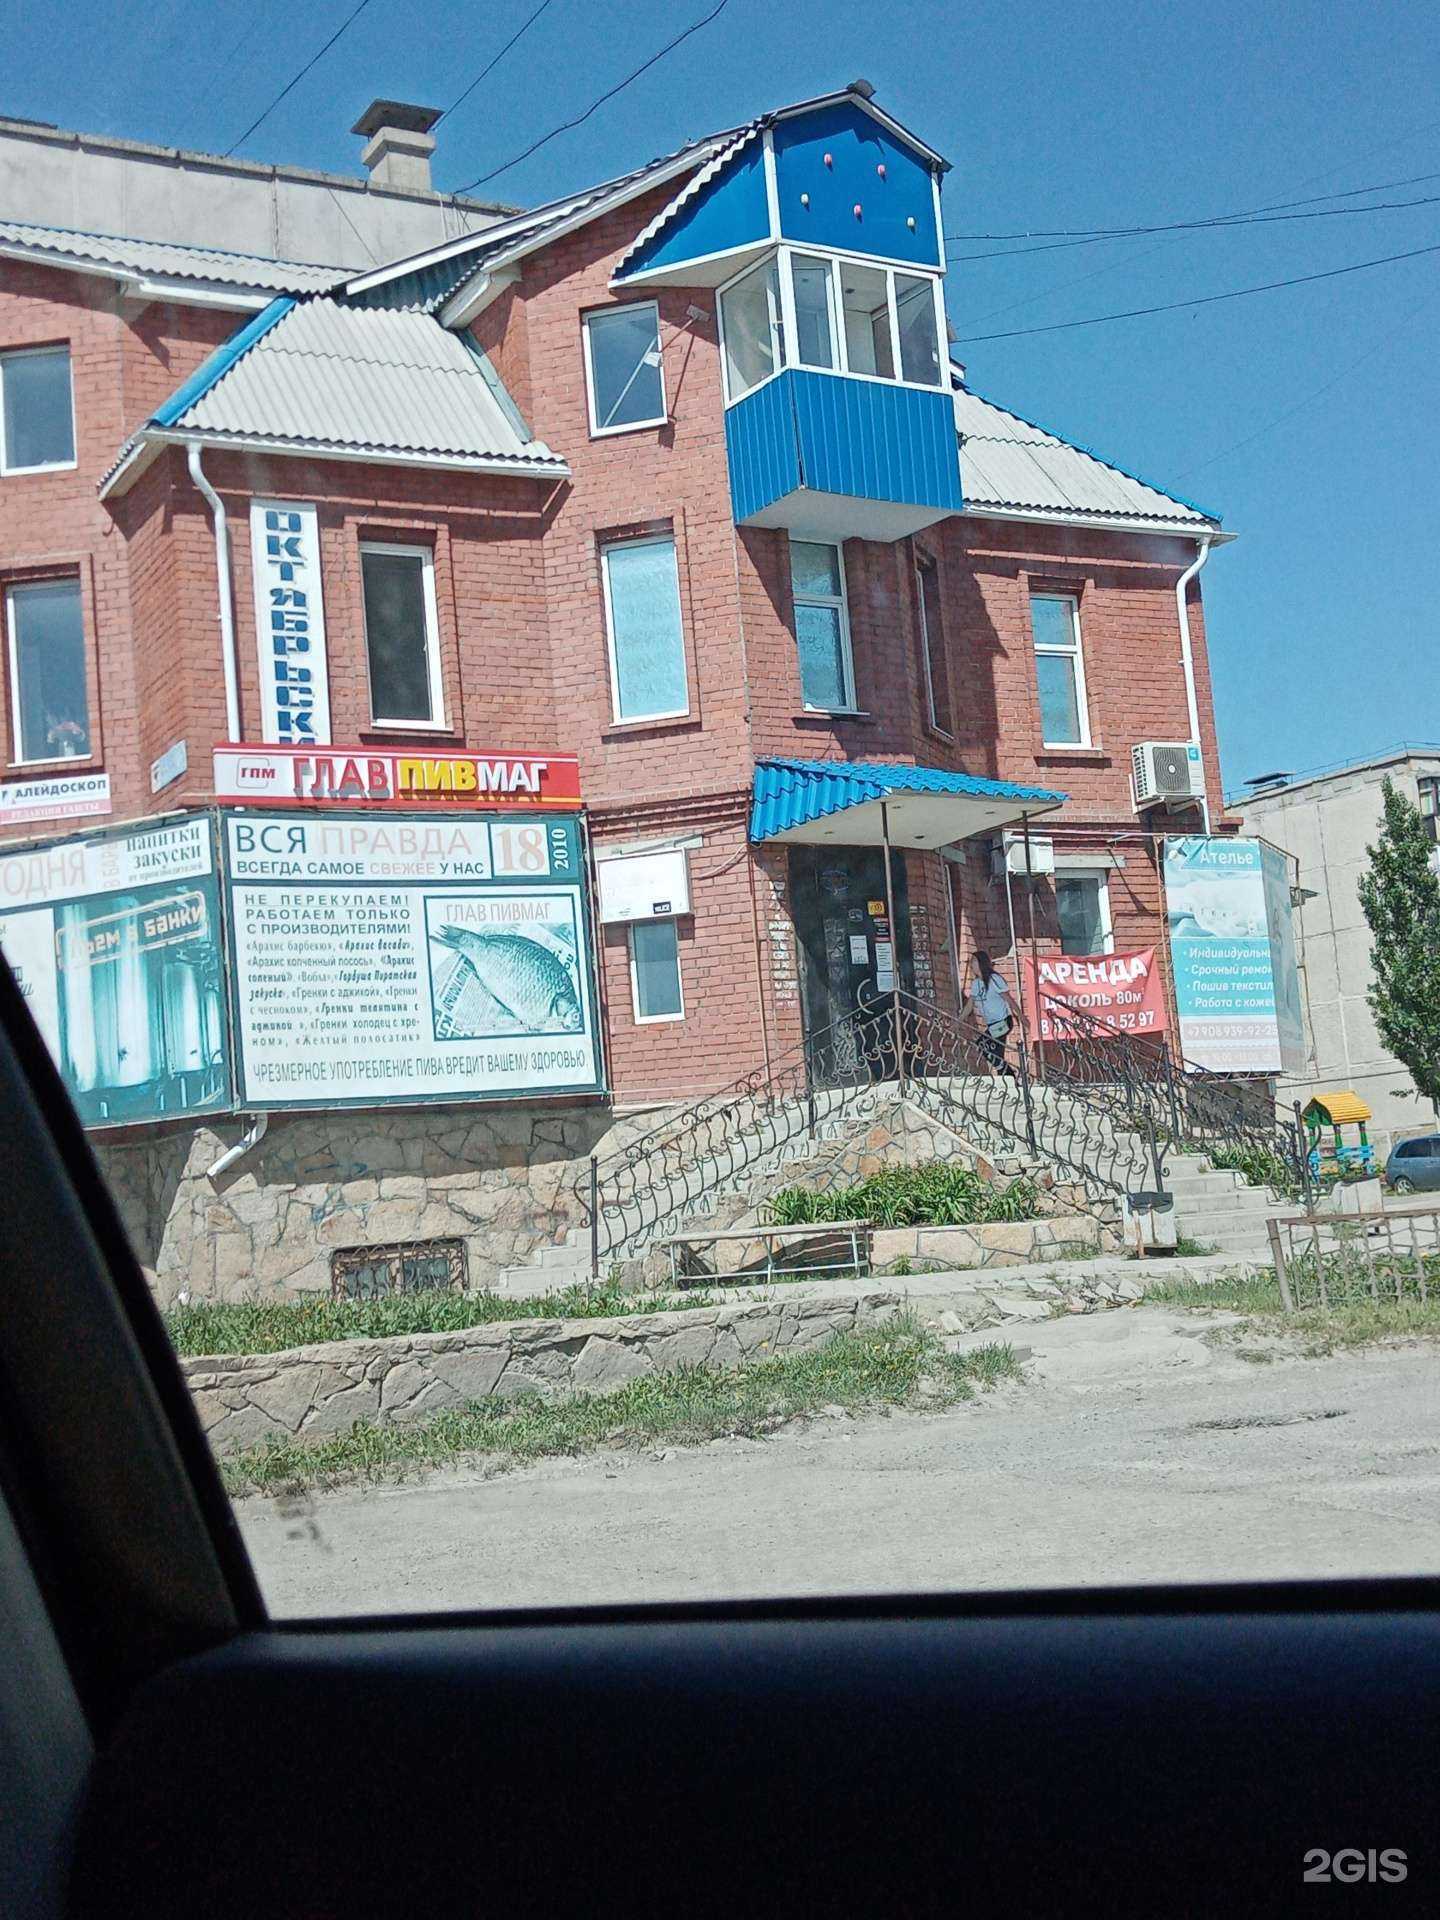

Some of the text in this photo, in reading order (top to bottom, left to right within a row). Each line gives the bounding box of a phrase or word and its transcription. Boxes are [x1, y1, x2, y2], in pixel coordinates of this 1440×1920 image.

[293, 757, 389, 795] ГЛАВ
[236, 824, 473, 861] ВСЯ ПРАВДА
[495, 827, 546, 872] 18
[552, 828, 570, 870] 2010
[134, 845, 201, 869] закуски
[1200, 851, 1254, 865] Ателье
[236, 860, 485, 875] ВСЕГДА САМОЕ СВЕЖЕЕ У НАС
[245, 894, 409, 906] НЕ ПЕРЕКУПАЕМ!
[246, 909, 411, 920] РАБОТАЕМ ТОЛЬКО
[446, 903, 551, 922] ГЛАВ ПИВМАГ
[246, 923, 411, 936] С ПРОИЗВОДИТЕЛЯМИ!
[1038, 957, 1148, 986] АРЕНДА
[1191, 963, 1240, 976] Срочный
[1192, 980, 1229, 992] Пошив
[1194, 997, 1233, 1008] Работа
[1119, 1013, 1136, 1029] 52
[1138, 1010, 1155, 1025] 97
[253, 1061, 327, 1084] ЧРЕЗМЕРНОЕ
[329, 1058, 414, 1081] УПОТРЕБЛЕНИЕ
[415, 1057, 444, 1077] ПИВА
[445, 1054, 485, 1076] ВРЕДИТ
[487, 1052, 530, 1073] ВАШЕМУ
